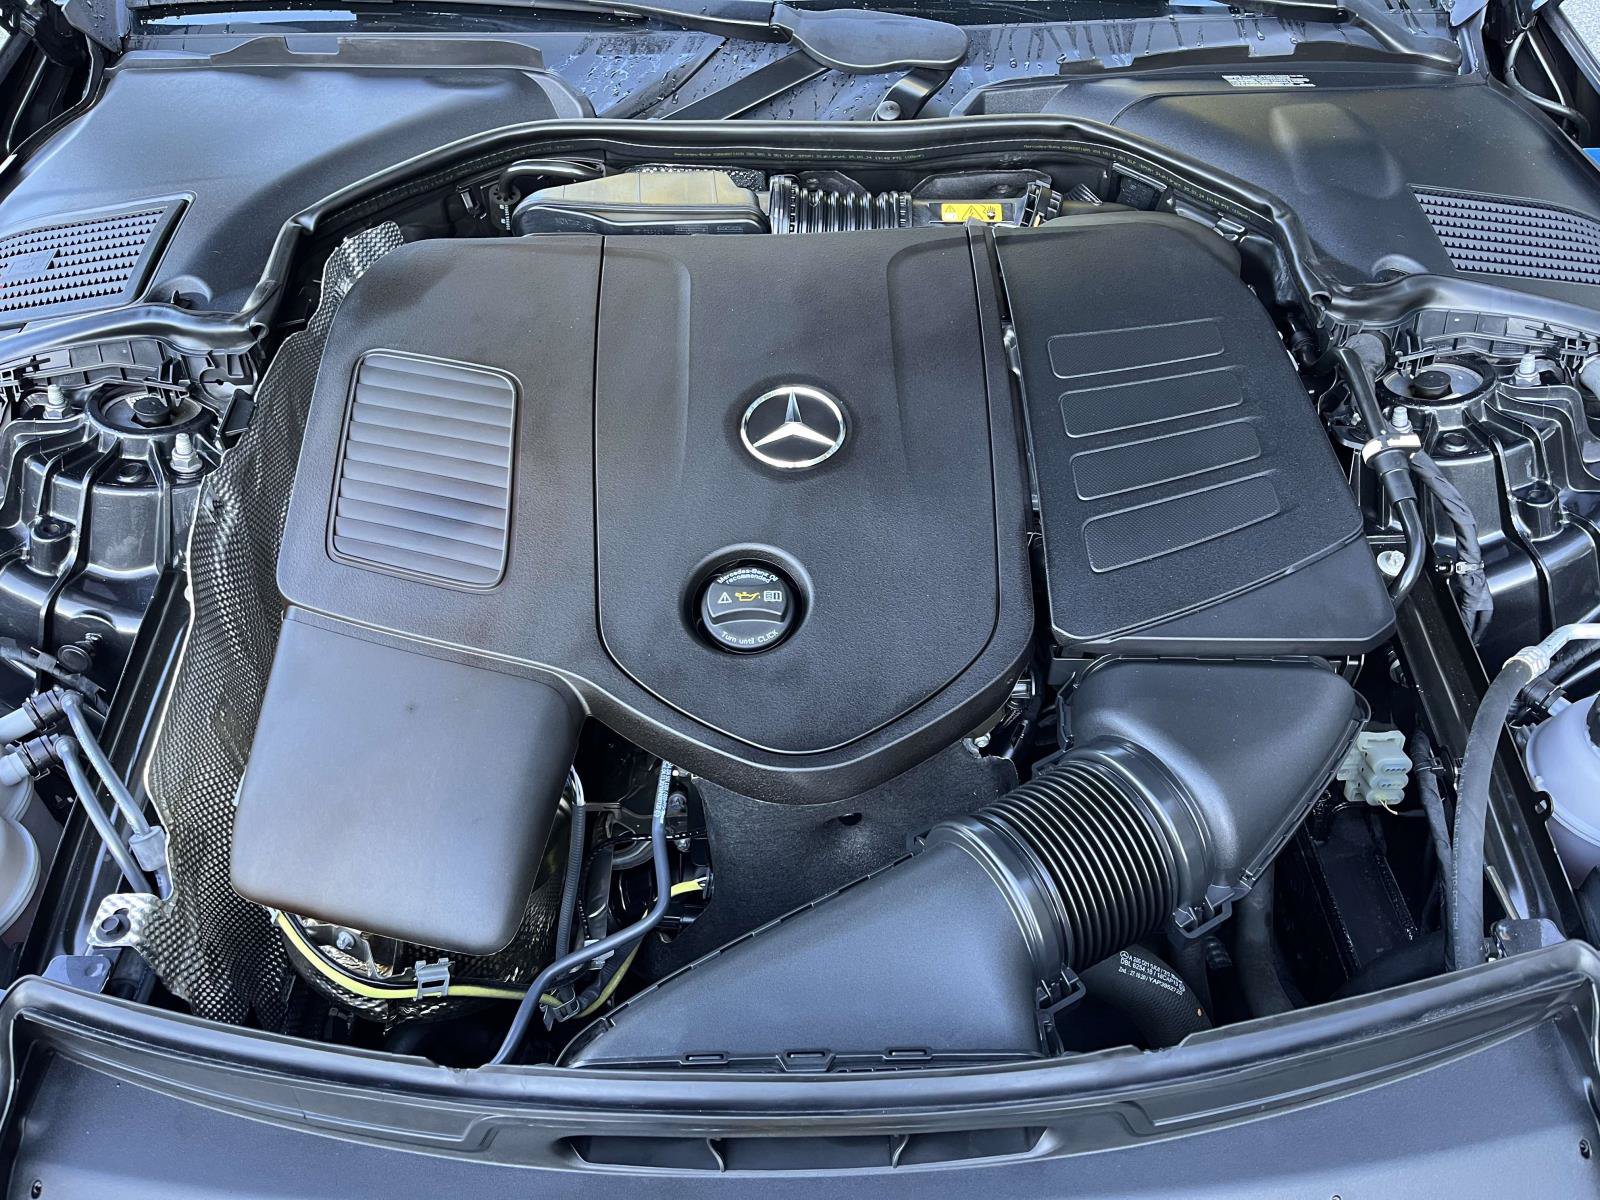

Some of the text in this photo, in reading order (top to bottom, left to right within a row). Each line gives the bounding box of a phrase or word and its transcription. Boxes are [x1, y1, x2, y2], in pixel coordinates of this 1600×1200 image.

[717, 569, 769, 584] Mercedes-Benz
[726, 573, 770, 584] recommended
[721, 630, 737, 643] Turn
[757, 628, 779, 643] CLICK
